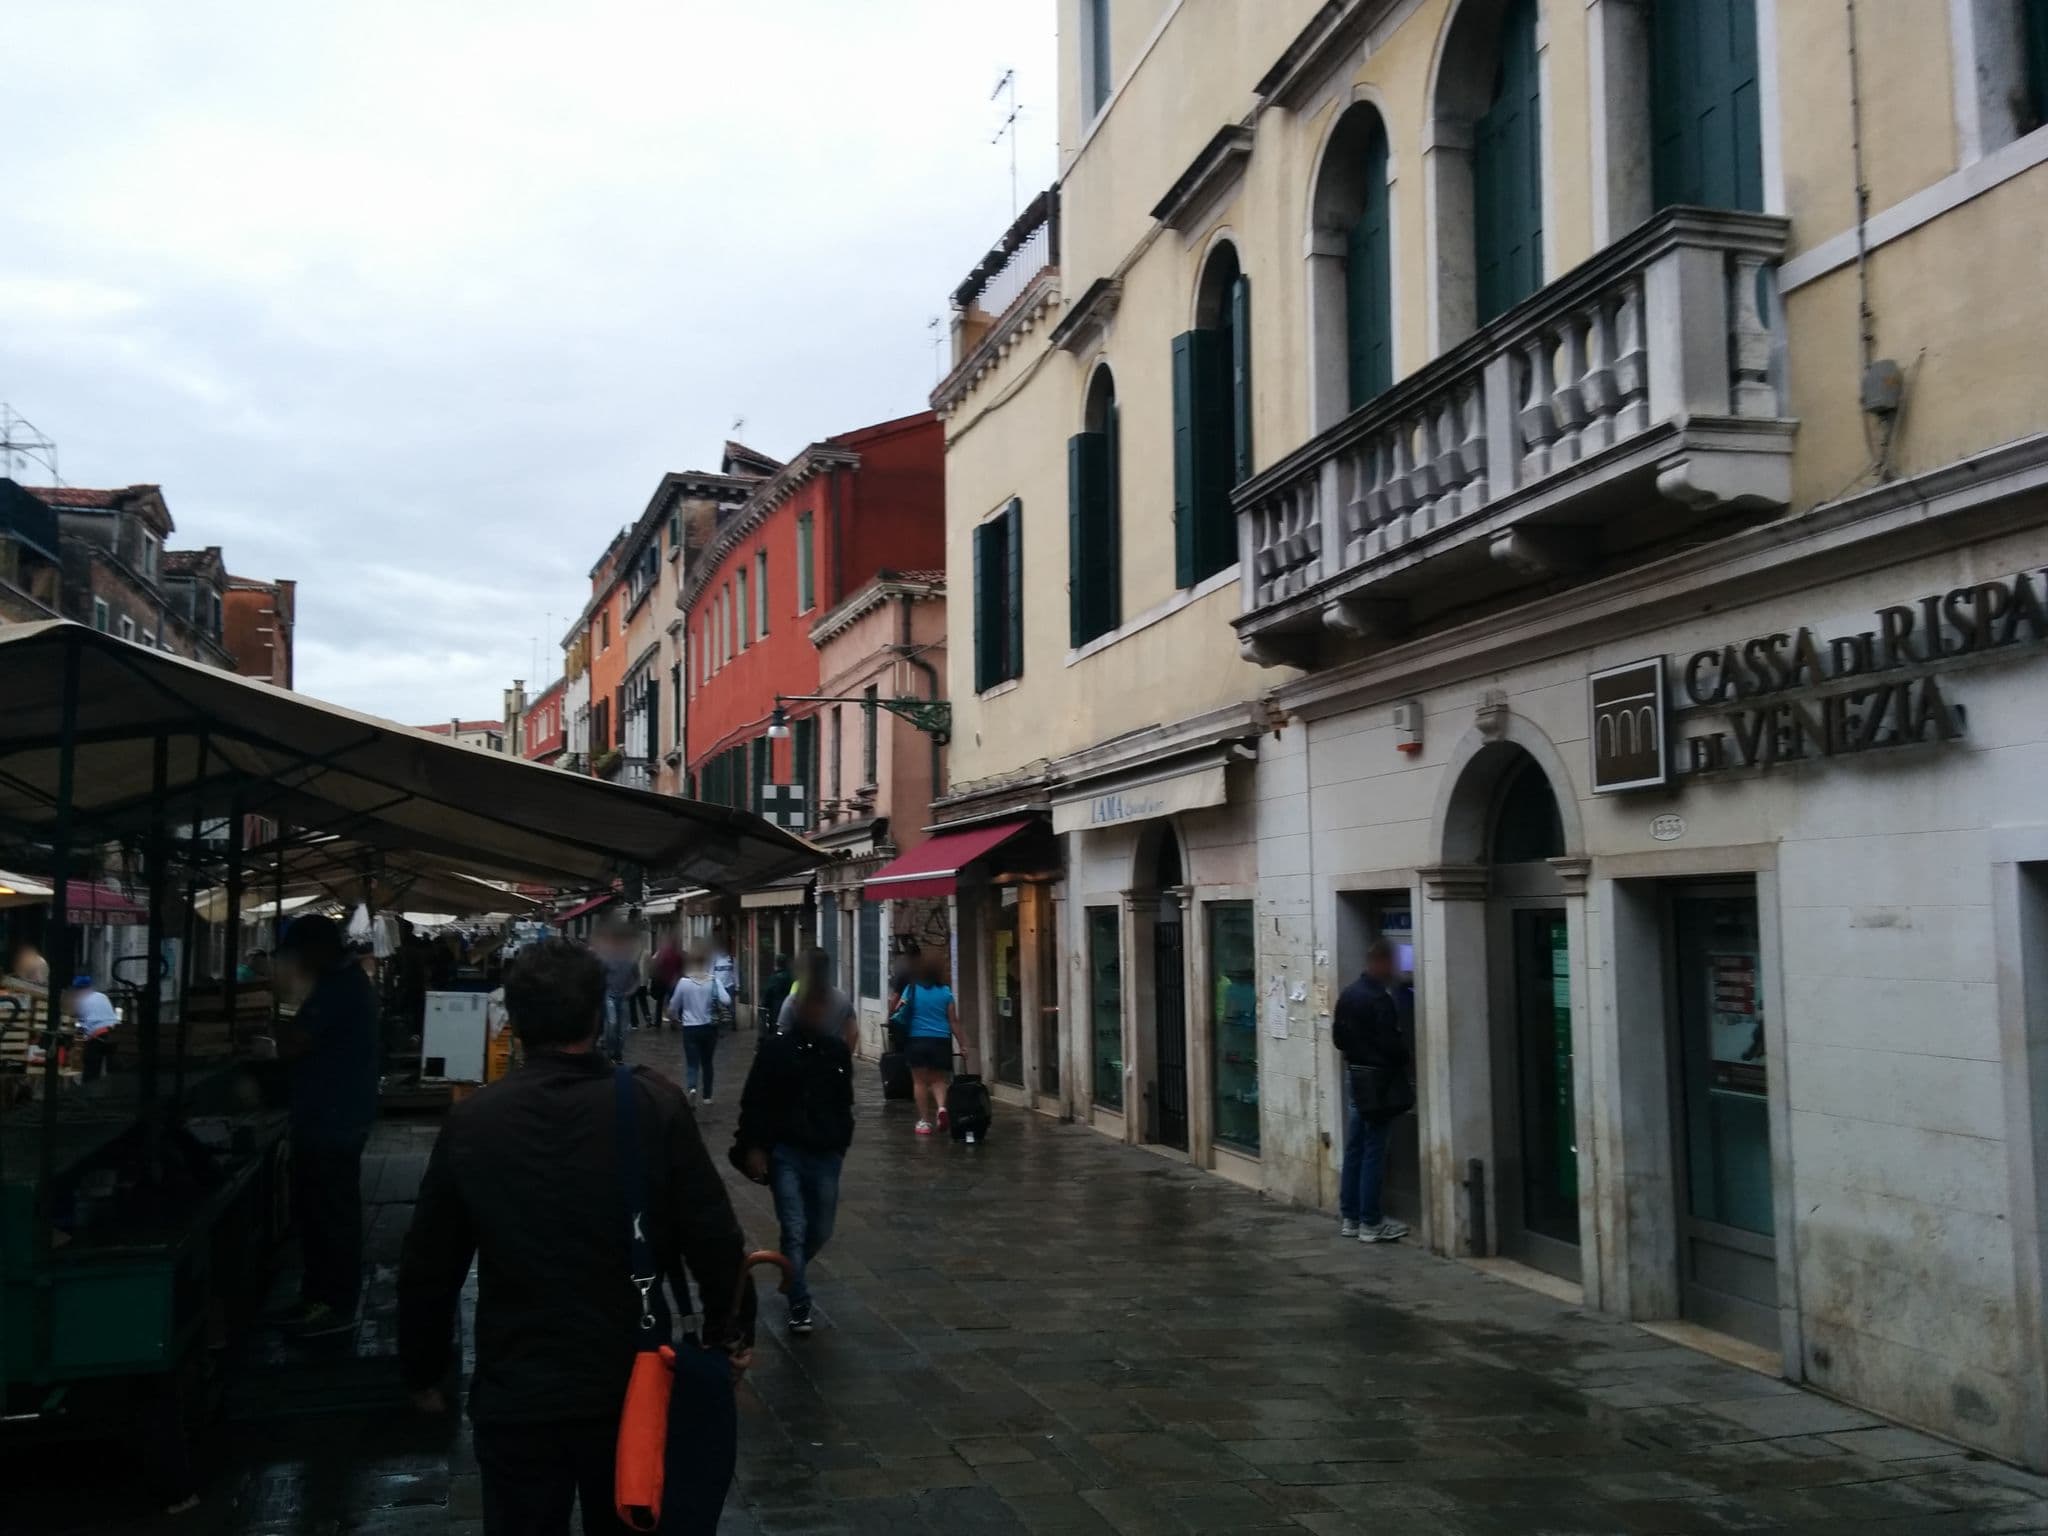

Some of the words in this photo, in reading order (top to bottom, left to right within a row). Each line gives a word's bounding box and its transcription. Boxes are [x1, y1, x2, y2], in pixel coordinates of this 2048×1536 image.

[1685, 626, 1826, 705] CASSA
[1875, 568, 2048, 668] RISPA
[1686, 733, 1727, 774] DI
[1727, 676, 1966, 768] VENEZIA
